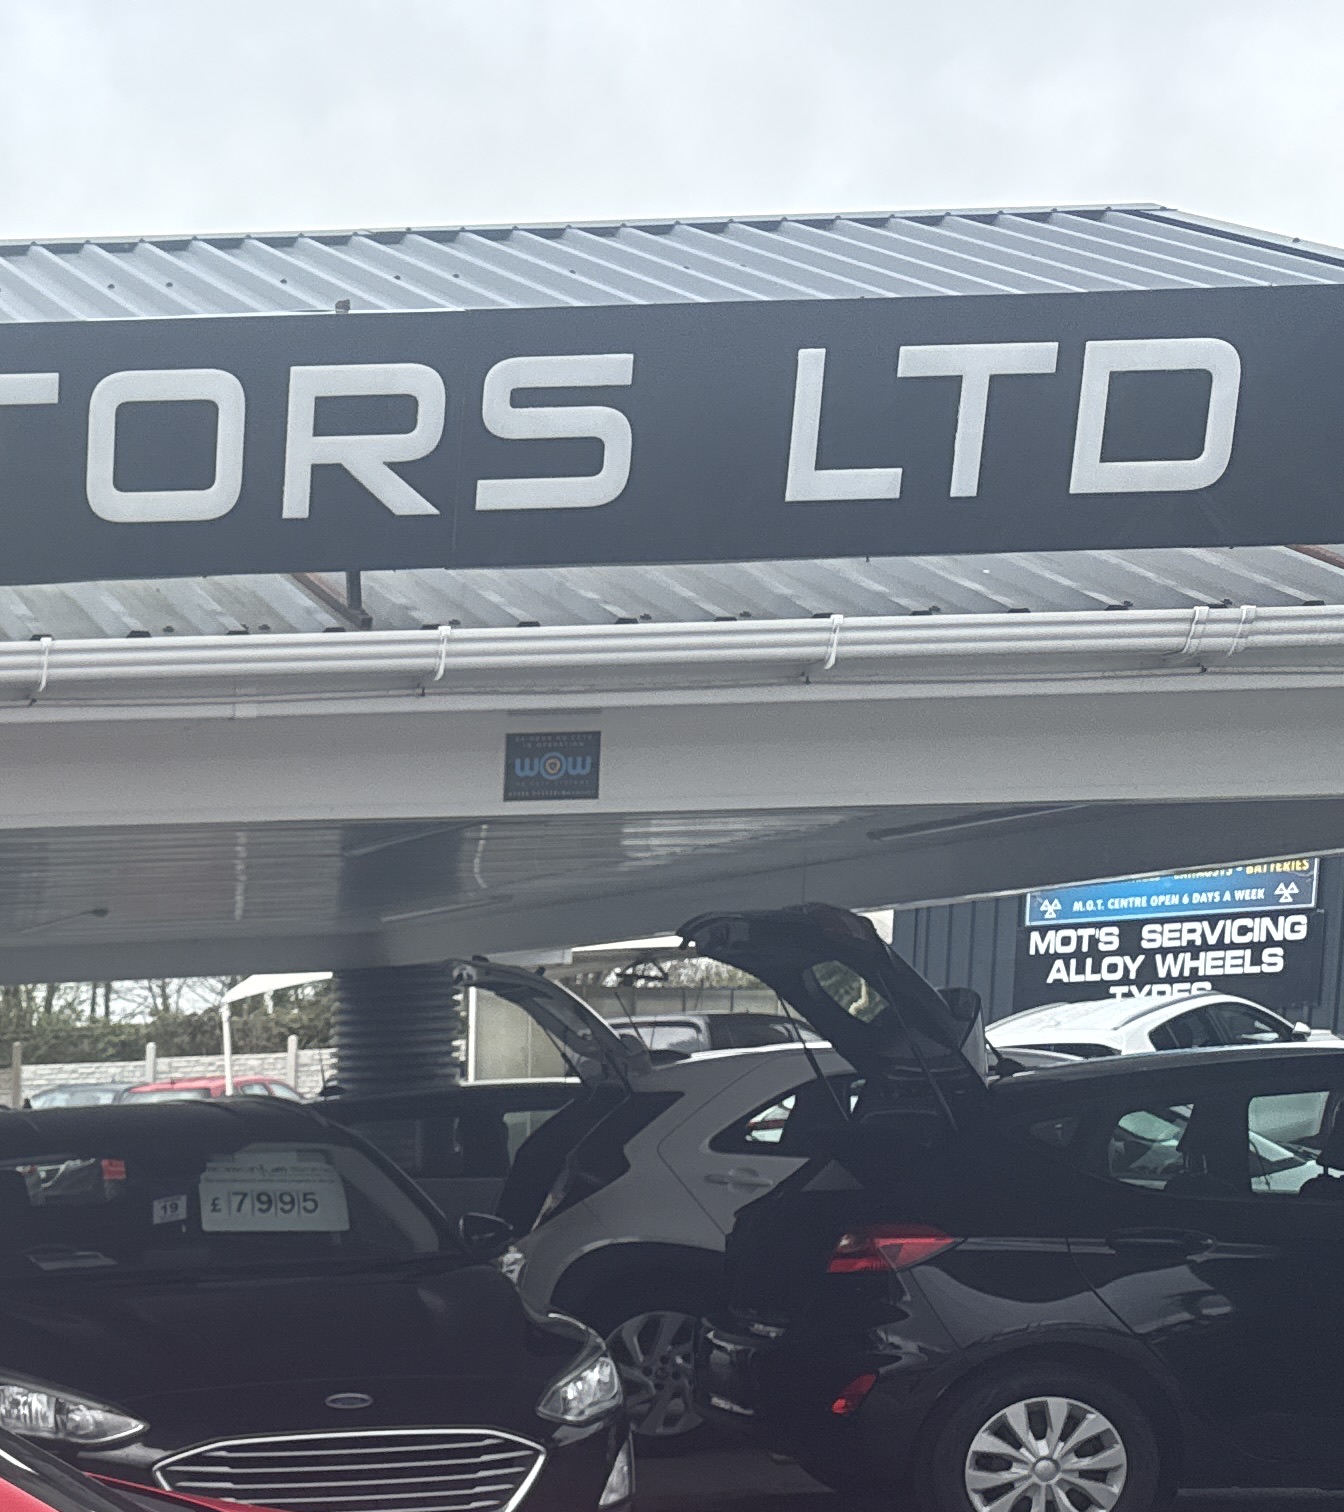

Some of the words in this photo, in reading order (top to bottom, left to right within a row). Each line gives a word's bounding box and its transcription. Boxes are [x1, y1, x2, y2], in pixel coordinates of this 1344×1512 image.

[784, 337, 1242, 504] LTD
[1072, 900, 1104, 912] M.O.T.
[1107, 896, 1147, 909] CENTRE
[1150, 893, 1180, 907] OPEN
[1181, 893, 1189, 904] 6
[1192, 890, 1220, 903] DAYS
[1222, 889, 1231, 902] A
[1234, 888, 1265, 901] WEEK
[1029, 926, 1120, 955] MOT'S
[1140, 914, 1308, 949] SERVICING
[1046, 954, 1146, 984] ALLOY
[1154, 947, 1285, 978] WHEELS
